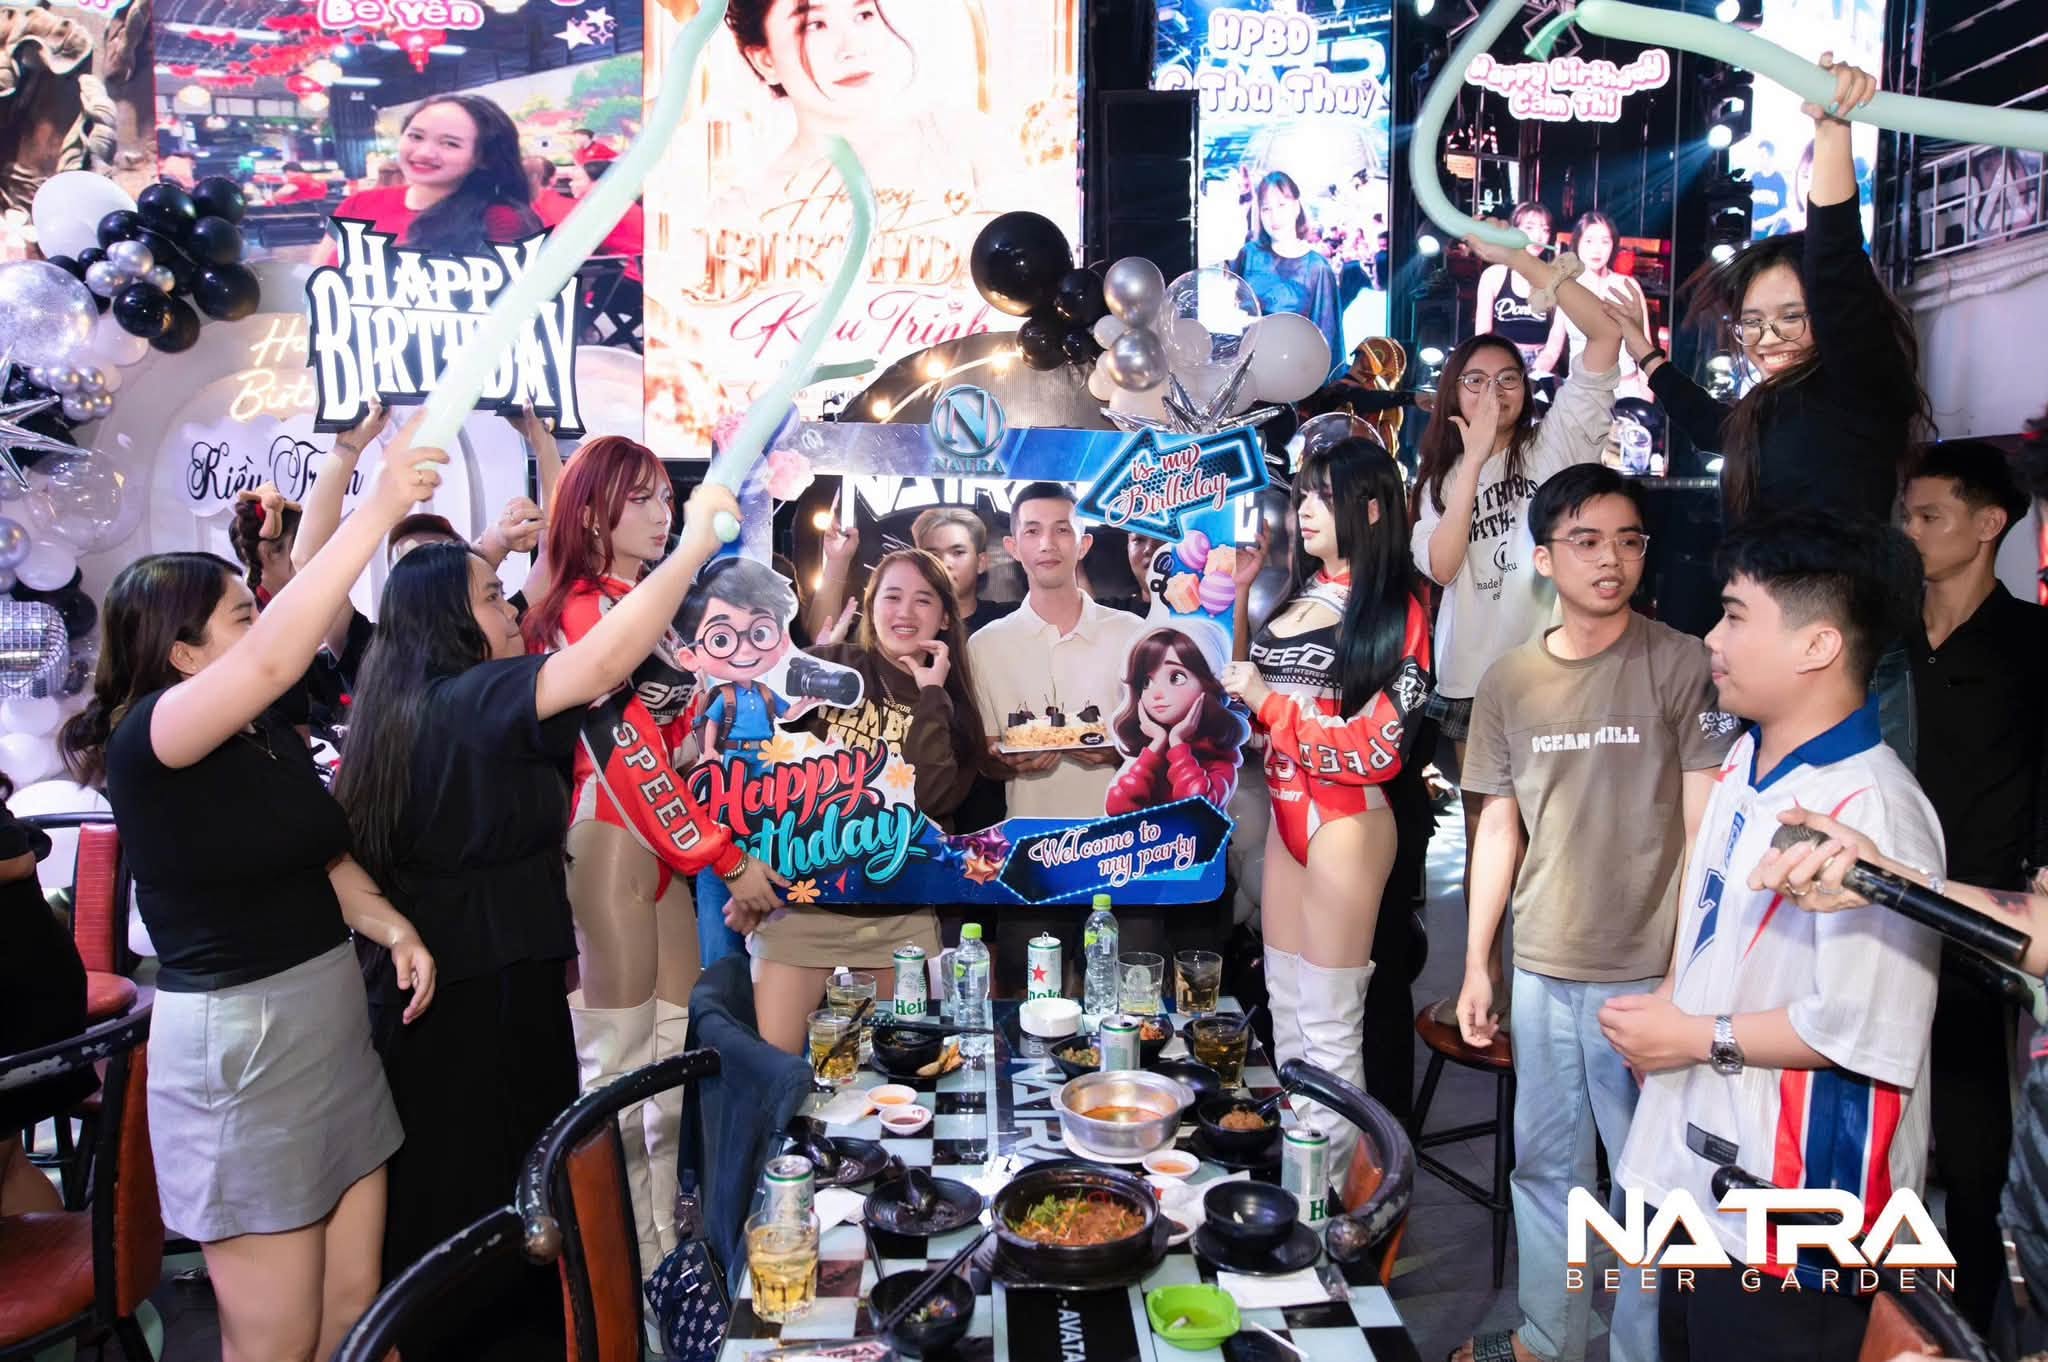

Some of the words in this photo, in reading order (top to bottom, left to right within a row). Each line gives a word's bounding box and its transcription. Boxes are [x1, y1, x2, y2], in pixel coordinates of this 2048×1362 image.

[1213, 13, 1310, 57] HPBD
[932, 457, 1006, 476] NATRA
[1132, 459, 1155, 481] is
[1162, 443, 1201, 474] my
[1105, 469, 1230, 527] Birthday
[1250, 641, 1336, 671] PEED
[1531, 732, 1591, 753] OCEAN
[612, 721, 701, 851] SPEED
[688, 741, 890, 836] Happy
[1029, 822, 1135, 868] Welcome
[1139, 820, 1161, 849] to
[1098, 855, 1132, 888] my
[1134, 833, 1198, 877] party
